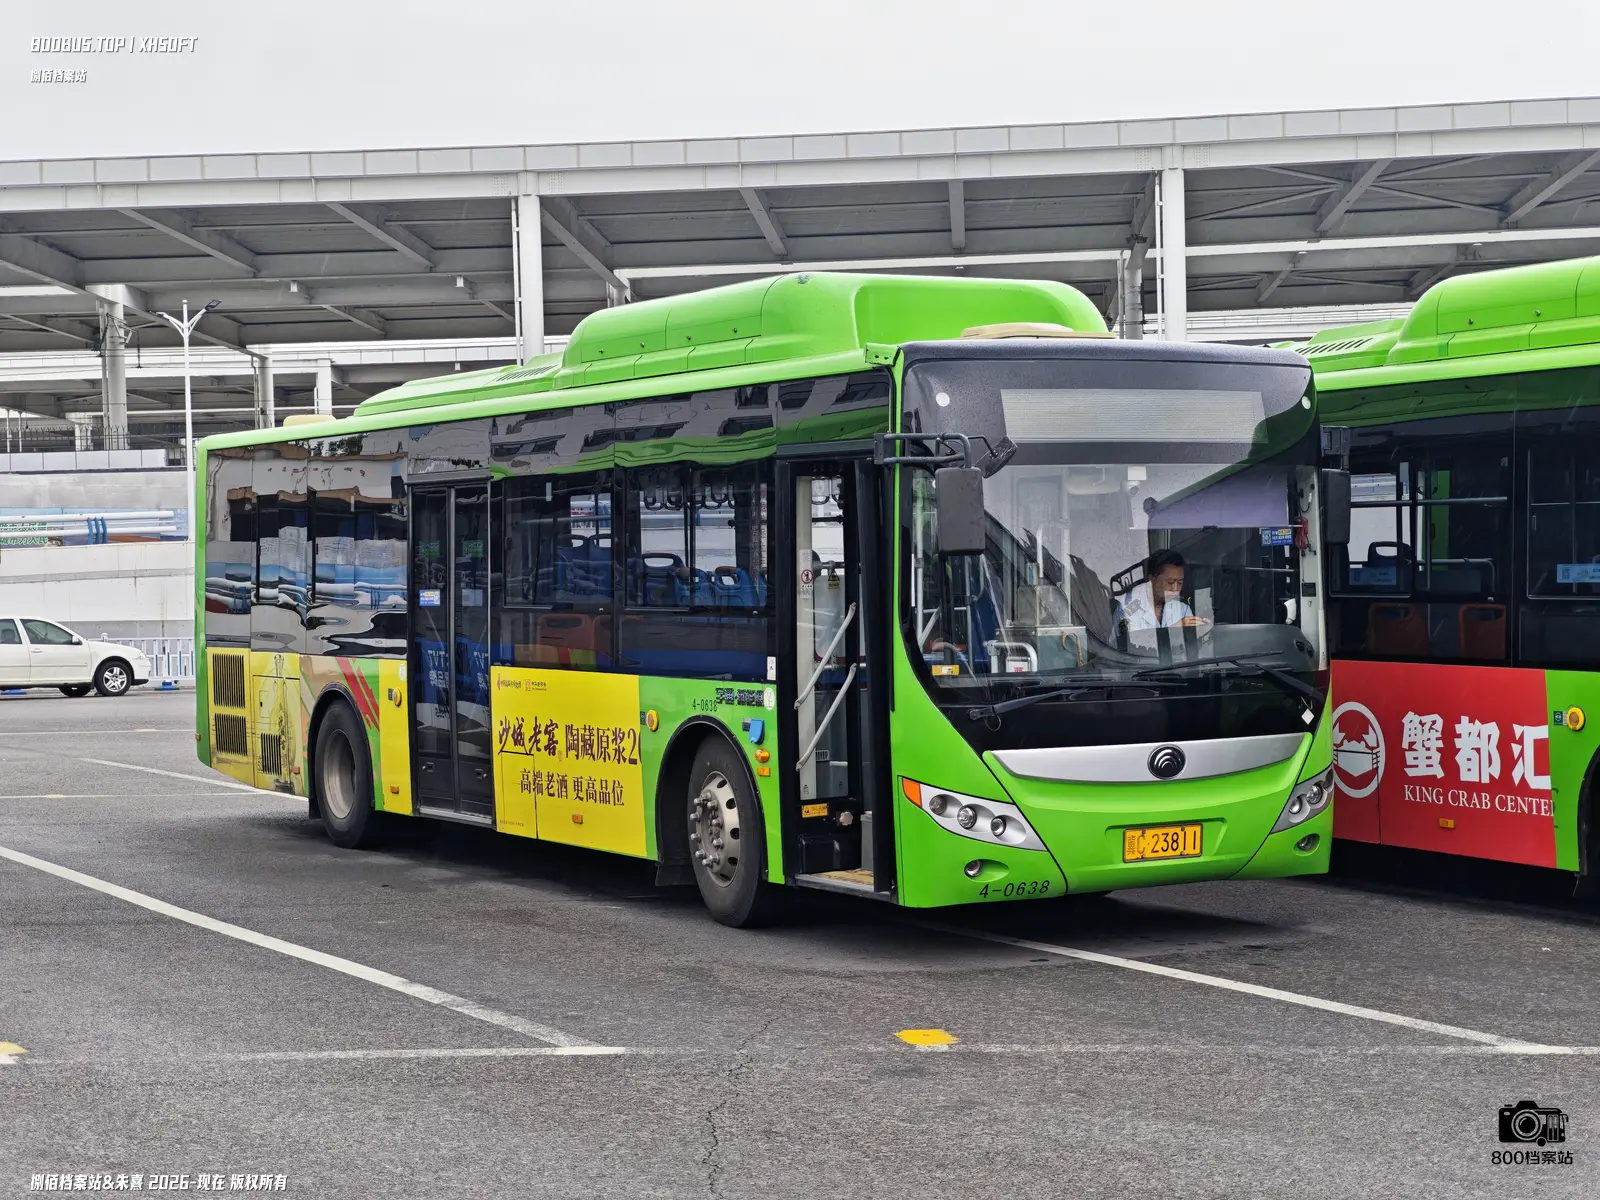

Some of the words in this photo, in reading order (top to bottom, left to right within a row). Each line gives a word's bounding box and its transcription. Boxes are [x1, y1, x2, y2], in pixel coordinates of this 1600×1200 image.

[692, 698, 718, 712] 4-0638
[565, 723, 642, 766] 陶藏原浆2
[1401, 711, 1551, 790] 蟹都汇
[520, 768, 569, 800] 高端老酒
[572, 775, 625, 806] 更高品位
[1404, 785, 1444, 805] KING
[1448, 789, 1491, 809] CRAB
[979, 880, 1050, 898] 4-0638
